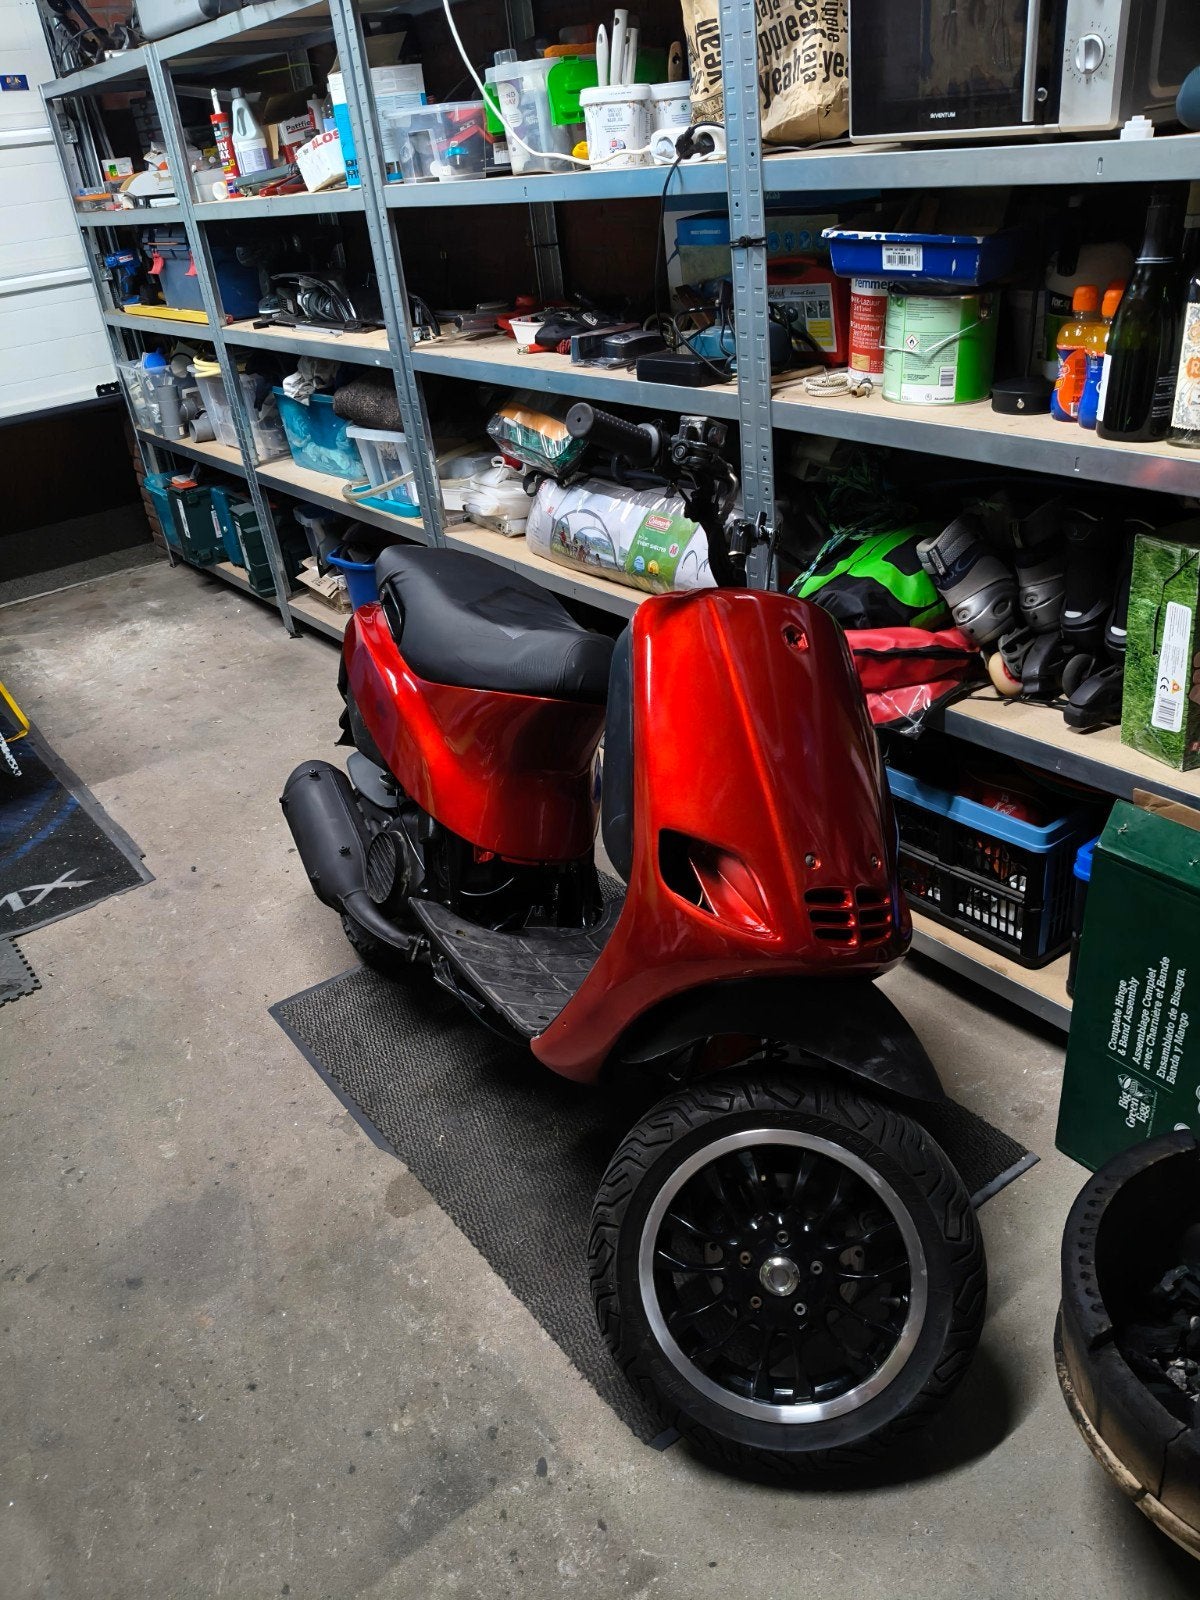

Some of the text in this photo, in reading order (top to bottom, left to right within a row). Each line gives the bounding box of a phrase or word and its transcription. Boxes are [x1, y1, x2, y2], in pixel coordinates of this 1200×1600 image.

[759, 48, 801, 109] yeah
[822, 50, 850, 83] ye
[1108, 980, 1128, 1050] Complete Hinge
[1123, 977, 1139, 1022] Assembly
[1132, 968, 1156, 1064] Assemblage Complet
[1144, 957, 1170, 1070] avec Charnière et Bande
[1156, 969, 1186, 1079] Ensamblado de Bisagra,
[1119, 1023, 1130, 1048] Band
[1166, 1013, 1189, 1084] Banda y Mango
[1118, 1091, 1132, 1109] Big
[1126, 1097, 1139, 1127] Green
[1136, 1102, 1150, 1122] Egg
